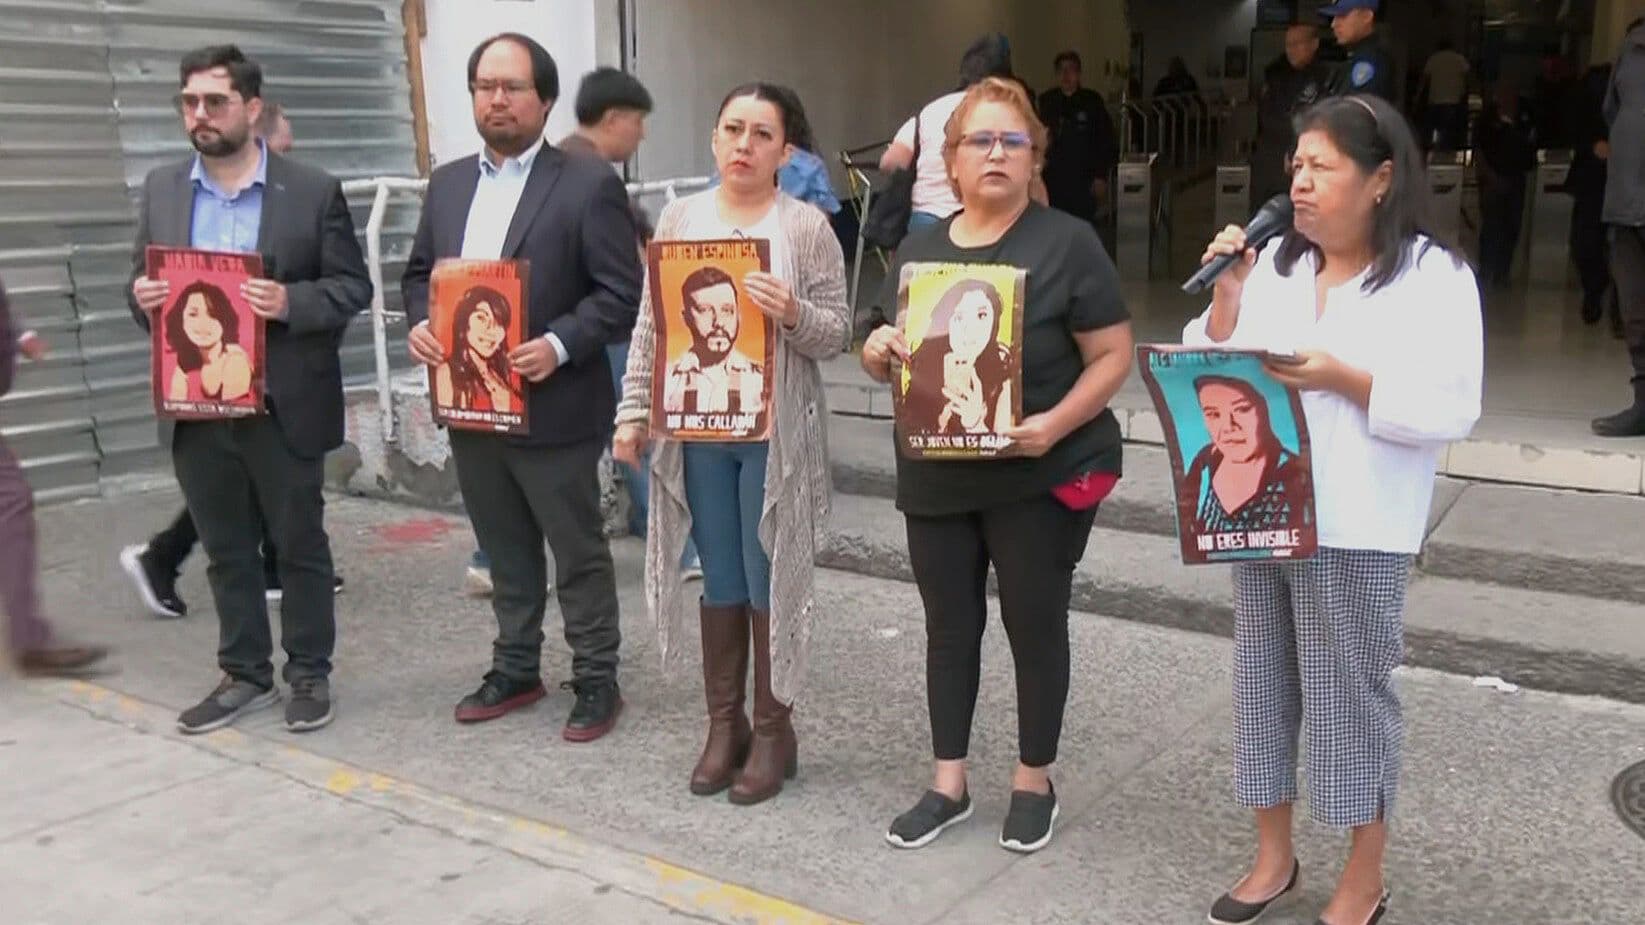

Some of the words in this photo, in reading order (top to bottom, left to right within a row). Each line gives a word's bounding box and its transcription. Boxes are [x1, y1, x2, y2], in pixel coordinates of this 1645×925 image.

[667, 414, 682, 429] NO
[684, 415, 705, 430] NOS
[1197, 534, 1214, 551] NO
[1216, 531, 1245, 550] ERES
[1247, 528, 1300, 549] INVISIBLE
